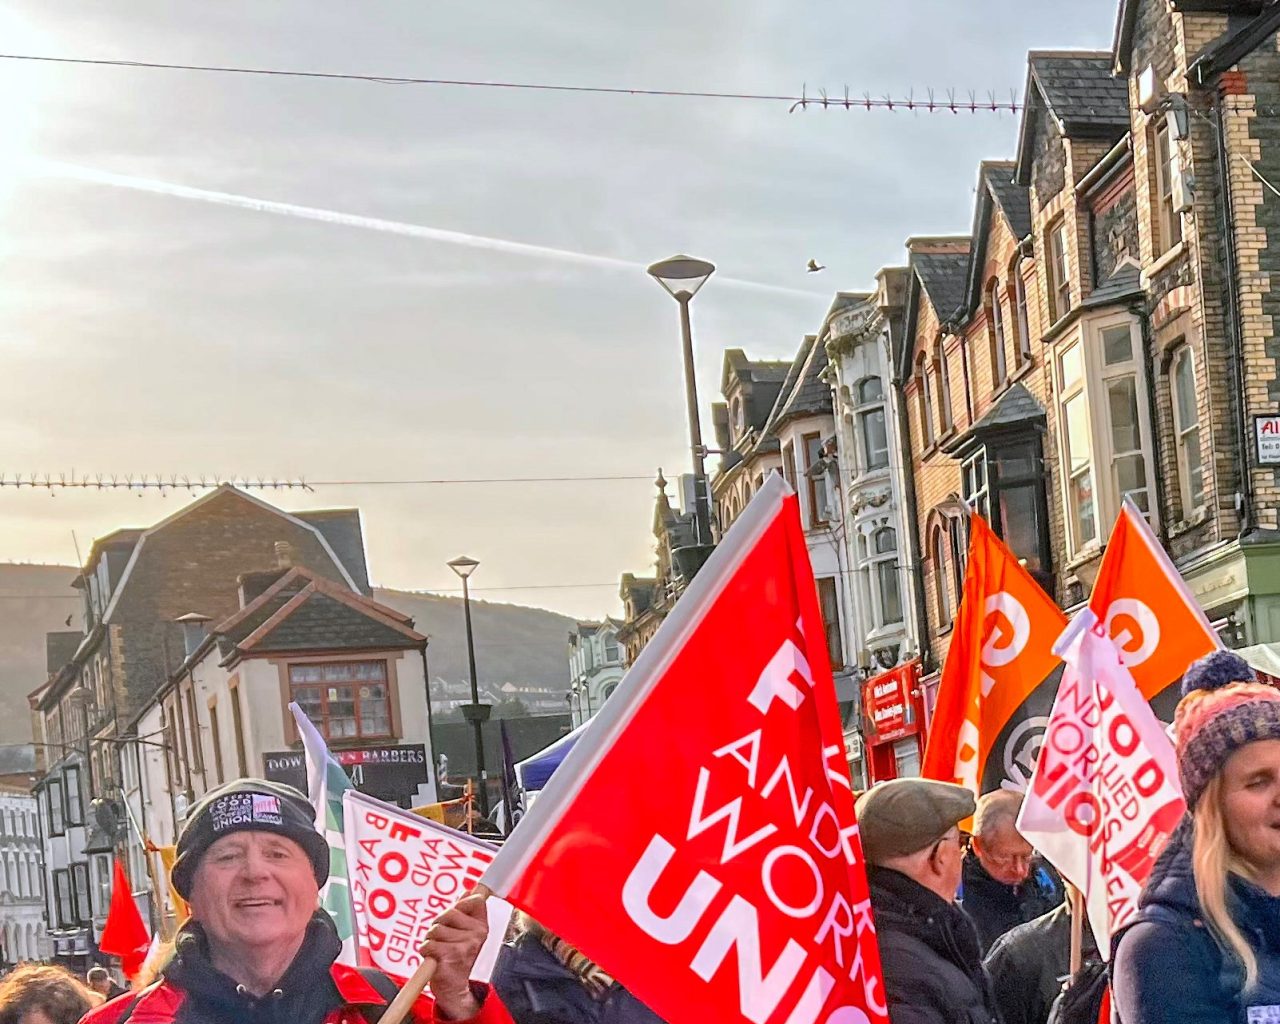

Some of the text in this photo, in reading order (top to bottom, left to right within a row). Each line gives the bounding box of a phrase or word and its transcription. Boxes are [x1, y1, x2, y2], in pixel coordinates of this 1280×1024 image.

[362, 750, 424, 764] BARBERS
[712, 728, 843, 859] AND
[213, 815, 252, 831] UNION
